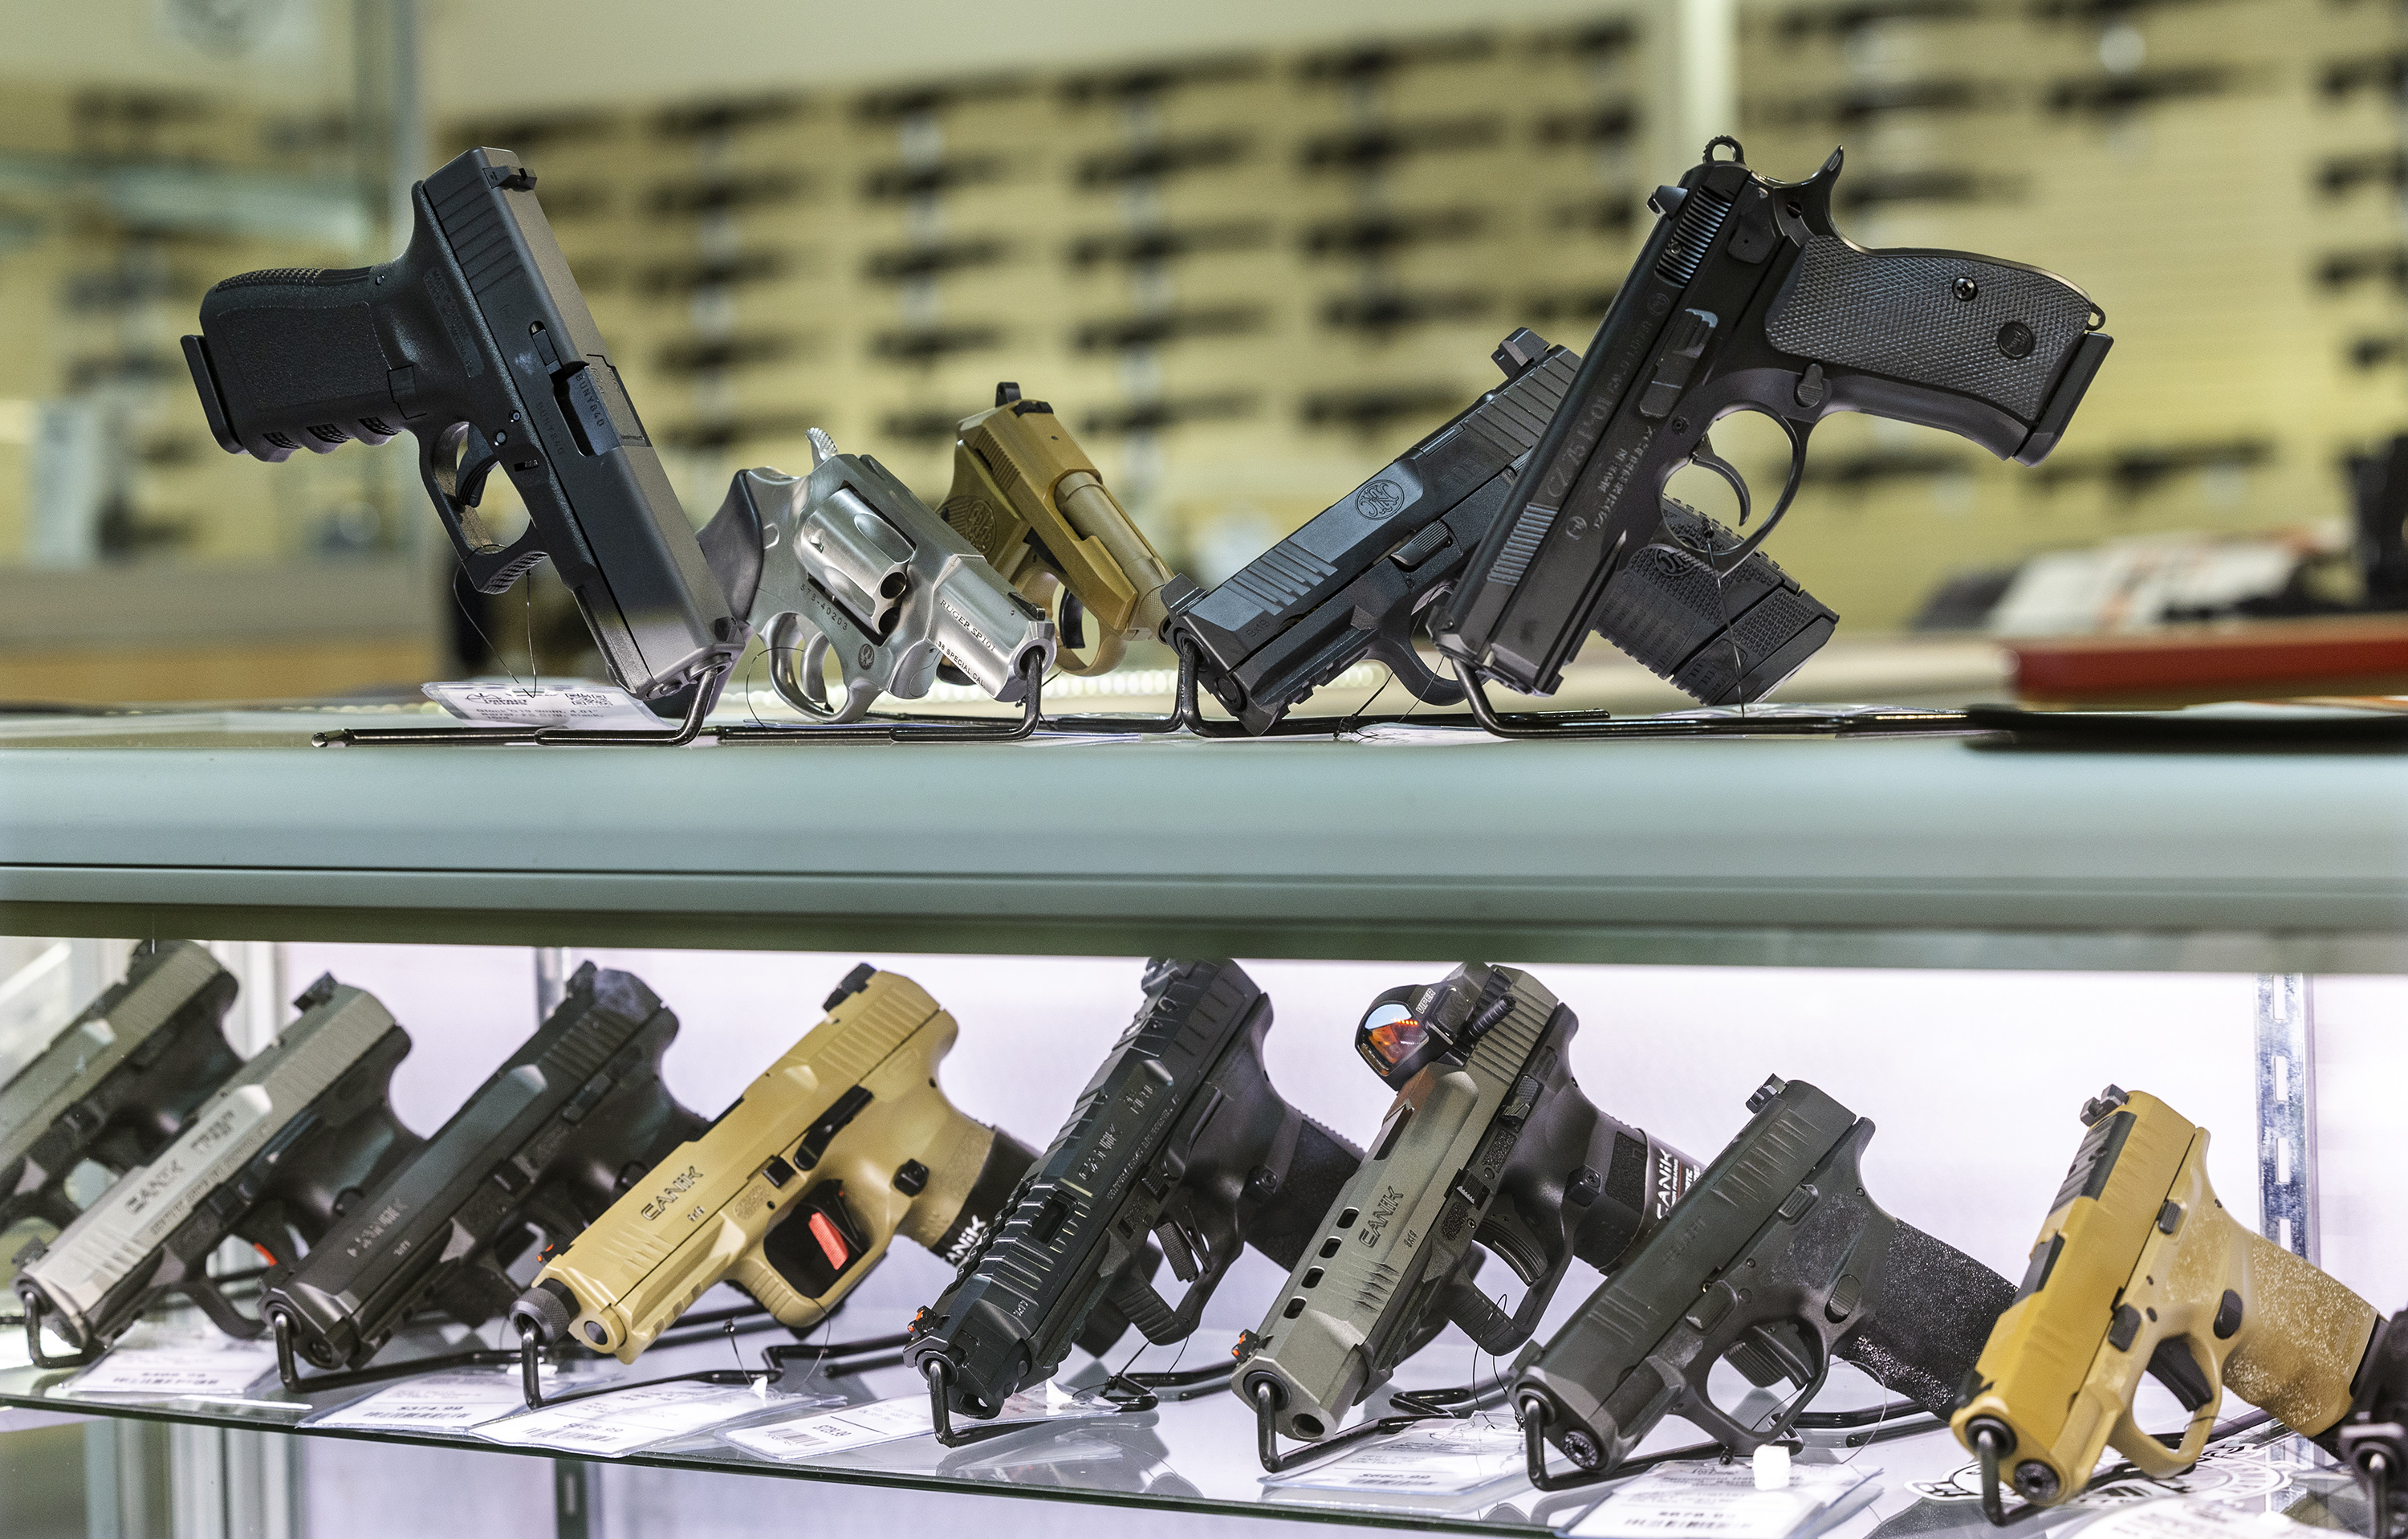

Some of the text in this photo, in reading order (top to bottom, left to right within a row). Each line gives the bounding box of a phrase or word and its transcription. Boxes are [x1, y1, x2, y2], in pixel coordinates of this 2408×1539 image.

[576, 373, 605, 426] BUNY840
[537, 401, 565, 456] BUNY840
[940, 600, 995, 652] RUGER SP101
[936, 641, 986, 689] .38 SPECIAL CAL.
[1415, 987, 1436, 1014] VIPER
